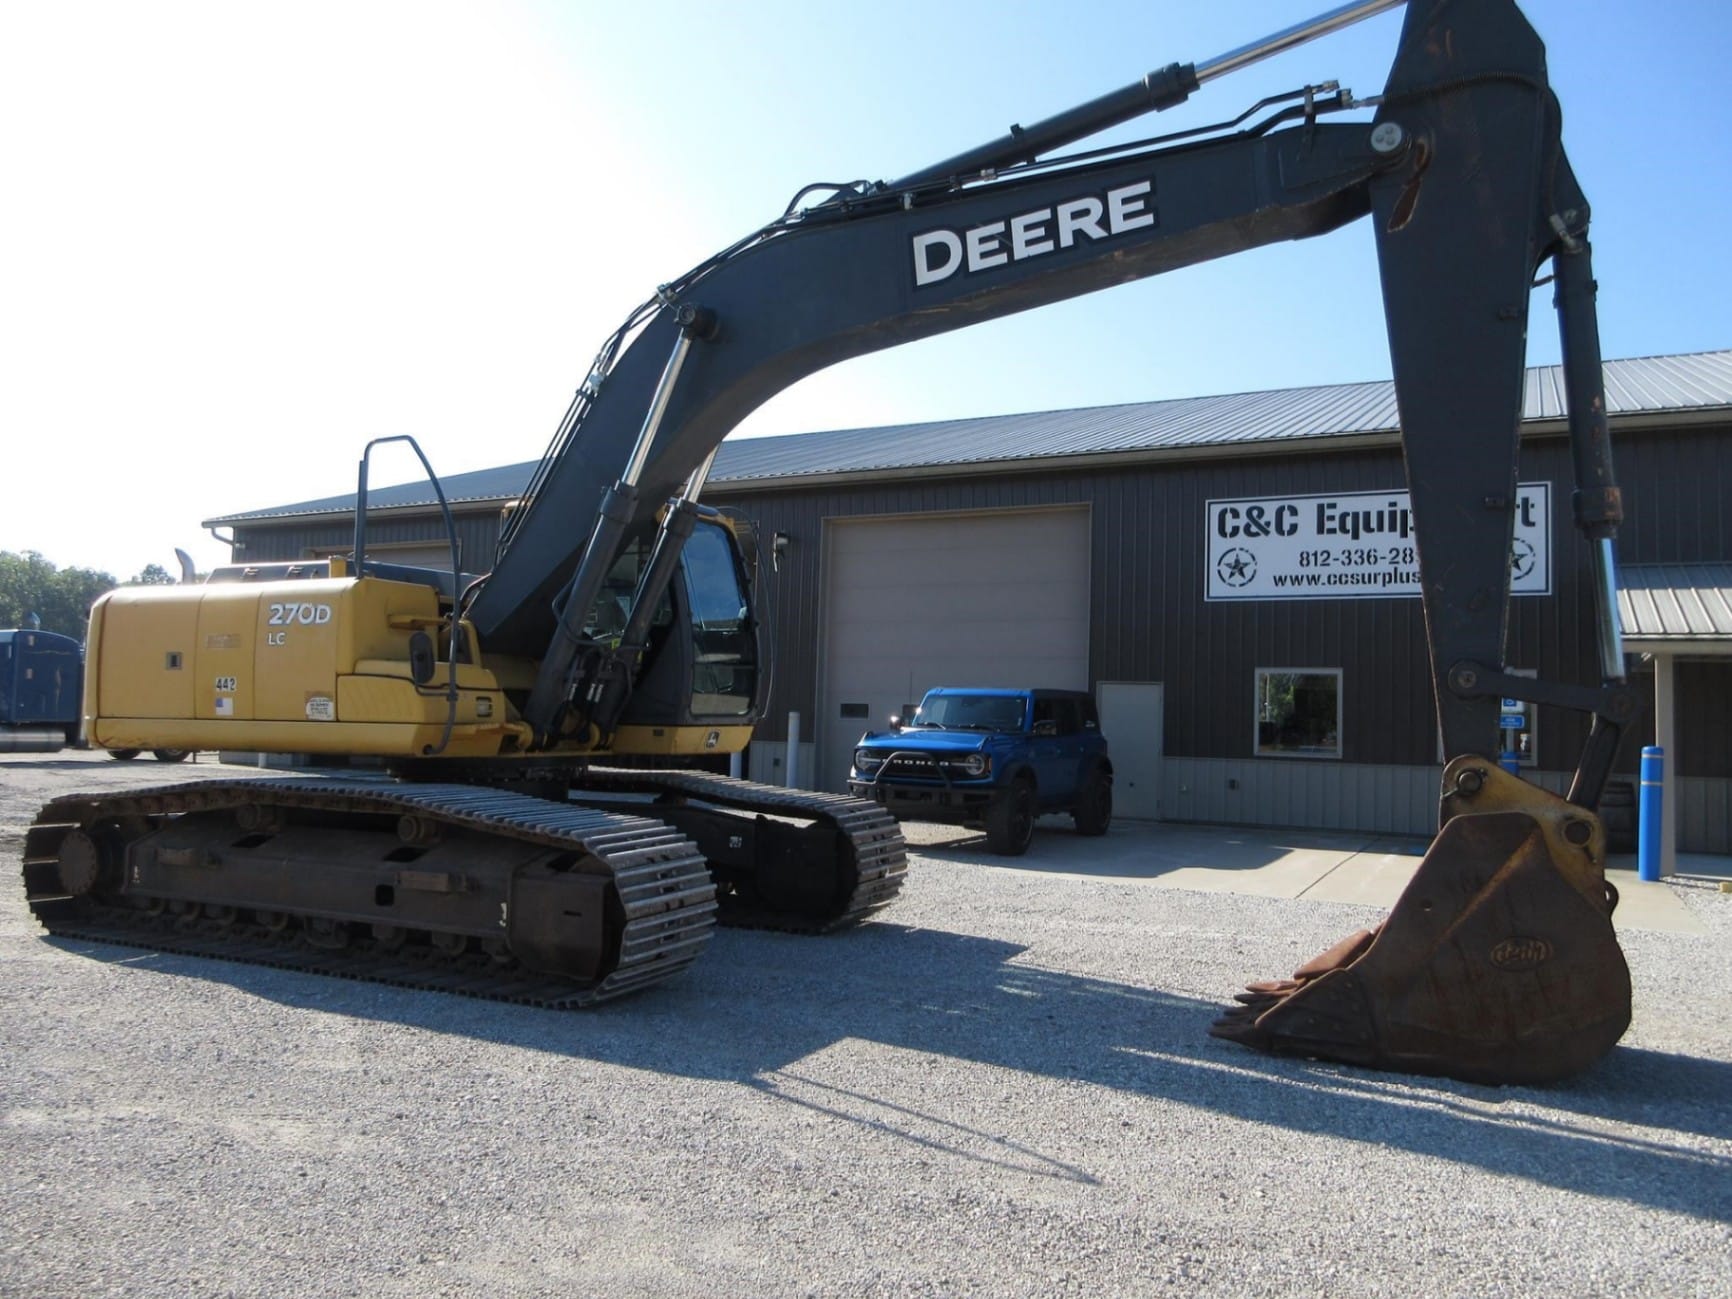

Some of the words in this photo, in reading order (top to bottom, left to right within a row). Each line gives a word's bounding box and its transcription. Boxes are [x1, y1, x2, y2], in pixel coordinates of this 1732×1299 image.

[913, 181, 1154, 286] DEERE
[1217, 504, 1299, 539] C&C
[1299, 548, 1420, 568] 812-336-28
[1273, 567, 1422, 589] www.ccsurplus
[269, 603, 331, 625] 270D
[268, 632, 286, 645] LC
[216, 678, 236, 691] 442
